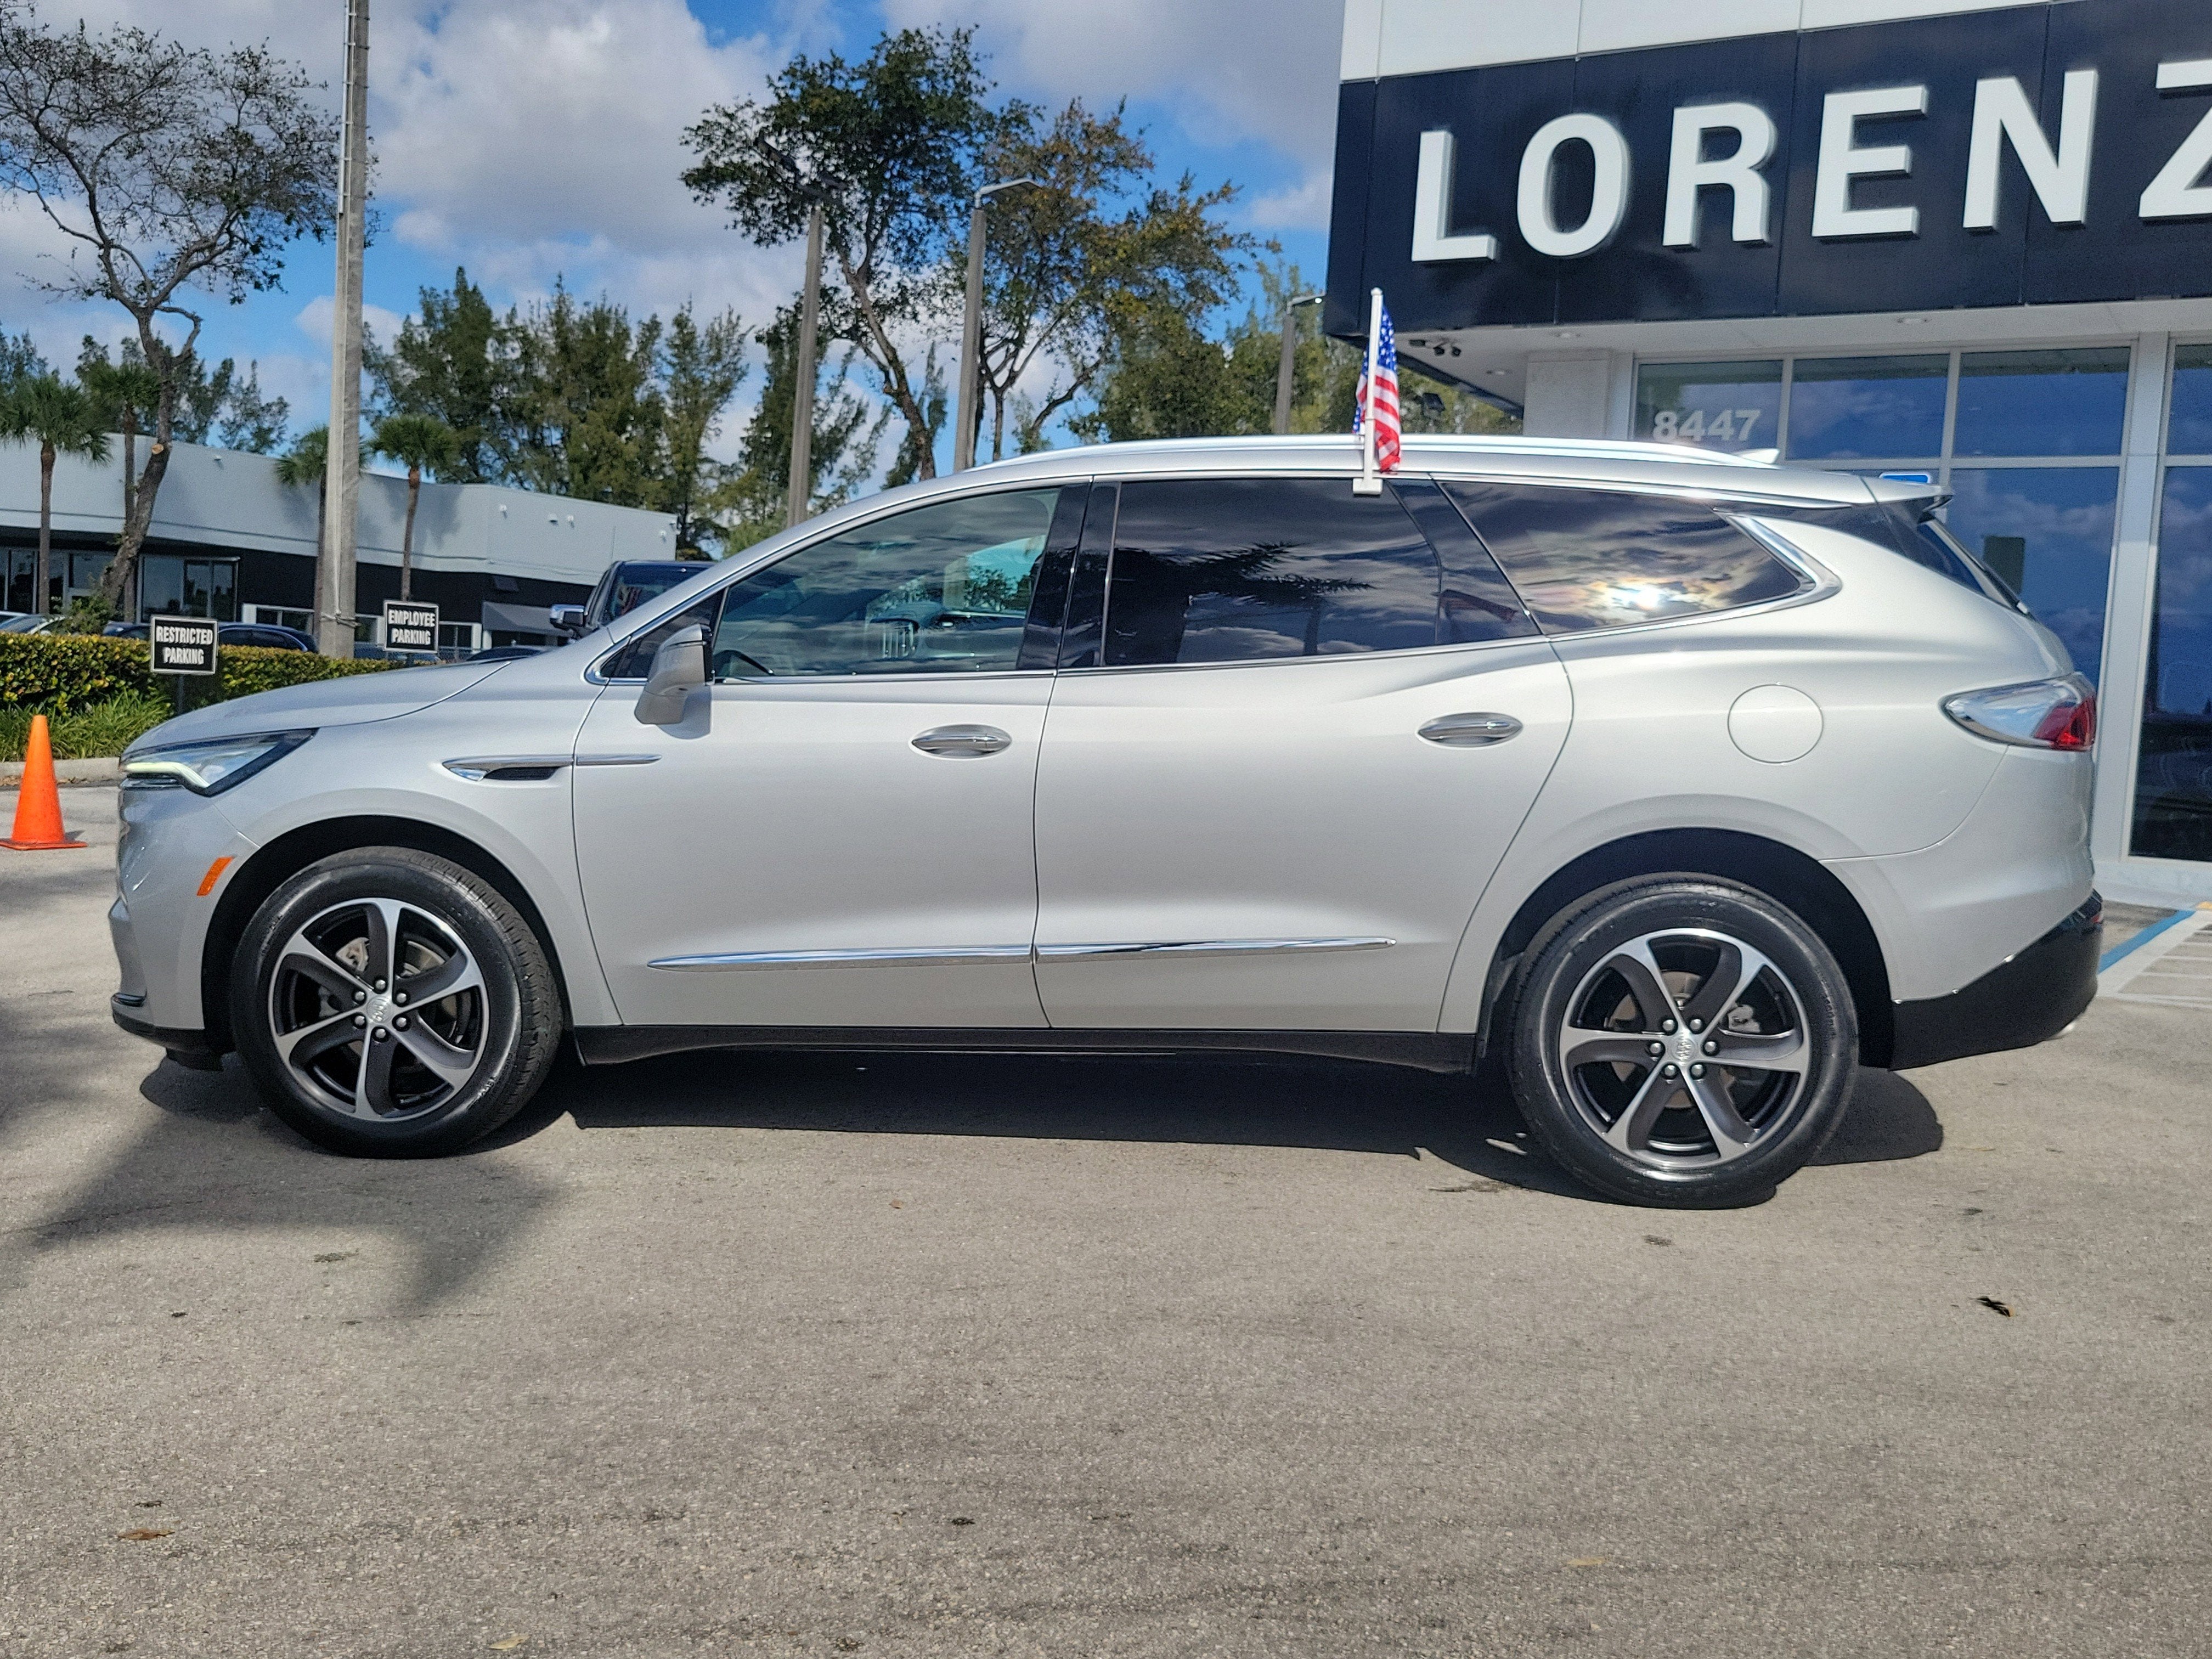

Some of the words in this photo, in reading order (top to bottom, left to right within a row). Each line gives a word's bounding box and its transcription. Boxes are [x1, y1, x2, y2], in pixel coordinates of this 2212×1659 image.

[1653, 410, 1760, 441] 8447
[388, 609, 436, 627] EMPLOYEE
[156, 626, 213, 645] RESTRICTED
[391, 628, 431, 645] PARKING
[163, 647, 204, 664] PARKING
